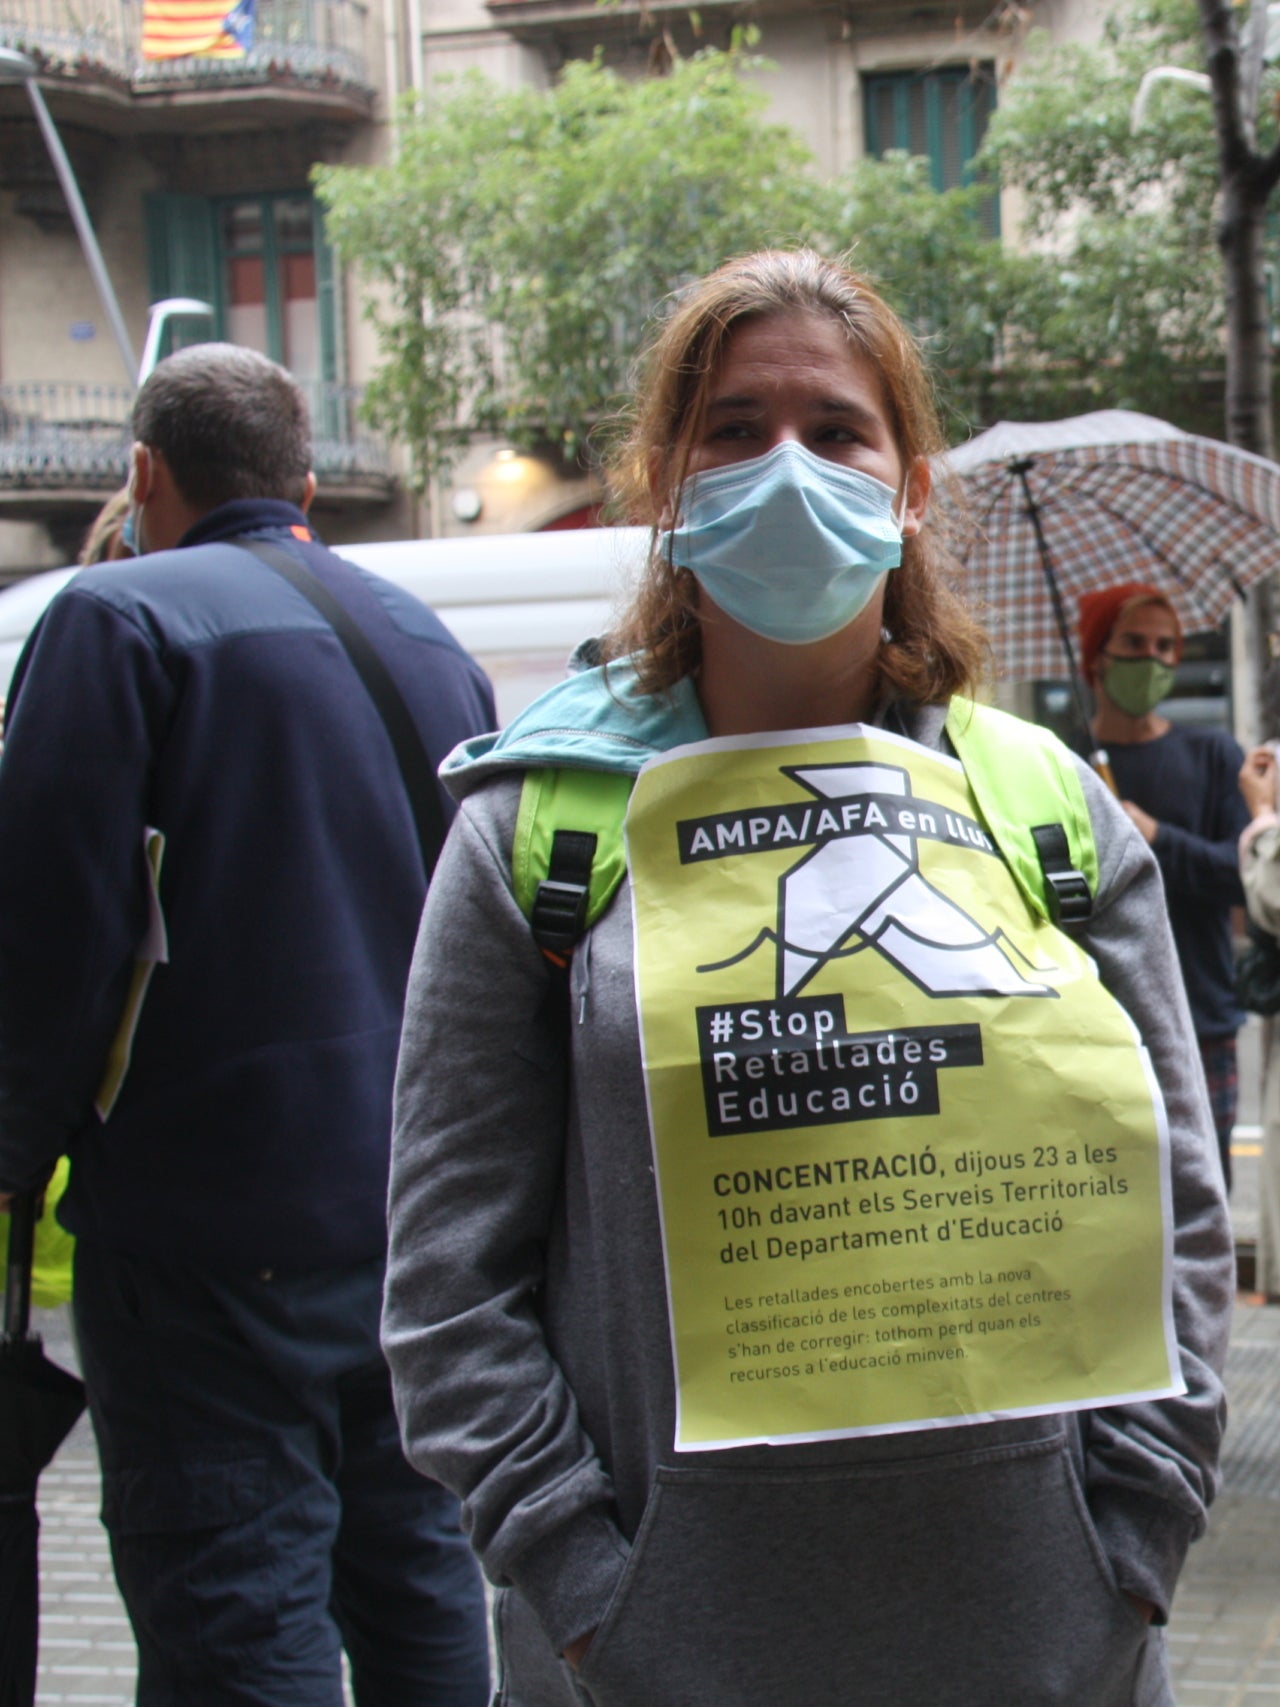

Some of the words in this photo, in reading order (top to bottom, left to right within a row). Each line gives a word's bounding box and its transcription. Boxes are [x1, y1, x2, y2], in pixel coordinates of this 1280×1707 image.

[691, 802, 887, 854] AMPA/AFA
[898, 810, 937, 834] en
[710, 1008, 834, 1044] #Stop
[714, 1035, 947, 1082] Retallades
[718, 1070, 919, 1123] Educació
[714, 1146, 946, 1198] CONCENTRACIÓ,
[954, 1150, 1026, 1177] dijous
[1033, 1145, 1059, 1168] 23
[1066, 1151, 1077, 1166] a
[1084, 1143, 1118, 1164] les
[718, 1206, 761, 1230] 10h
[770, 1197, 851, 1225] davant
[859, 1192, 895, 1214] els
[902, 1184, 994, 1211] Serveis
[1000, 1174, 1129, 1203] Territorials
[720, 1239, 759, 1264] del
[766, 1223, 929, 1261] Departament
[937, 1210, 1064, 1242] d'Educació
[724, 1296, 754, 1312] Les
[758, 1286, 839, 1307] retallades
[843, 1277, 935, 1297] encobertes
[939, 1271, 974, 1289] amb
[978, 1270, 993, 1285] la
[997, 1268, 1032, 1283] nova
[726, 1313, 824, 1335] classificació
[828, 1308, 848, 1324] de
[852, 1306, 876, 1321] les
[881, 1297, 984, 1318] complexitats
[988, 1291, 1011, 1308] del
[1015, 1289, 1072, 1305] centres
[728, 1343, 771, 1359] s'han
[776, 1339, 795, 1354] de
[801, 1333, 871, 1350] corregir:
[875, 1325, 933, 1343] tothom
[938, 1319, 974, 1340] perd
[978, 1319, 1012, 1337] quan
[1018, 1312, 1041, 1329] els
[729, 1364, 801, 1383] recursos
[805, 1363, 814, 1375] a
[819, 1353, 902, 1373] l'educació
[907, 1347, 969, 1364] minven.
